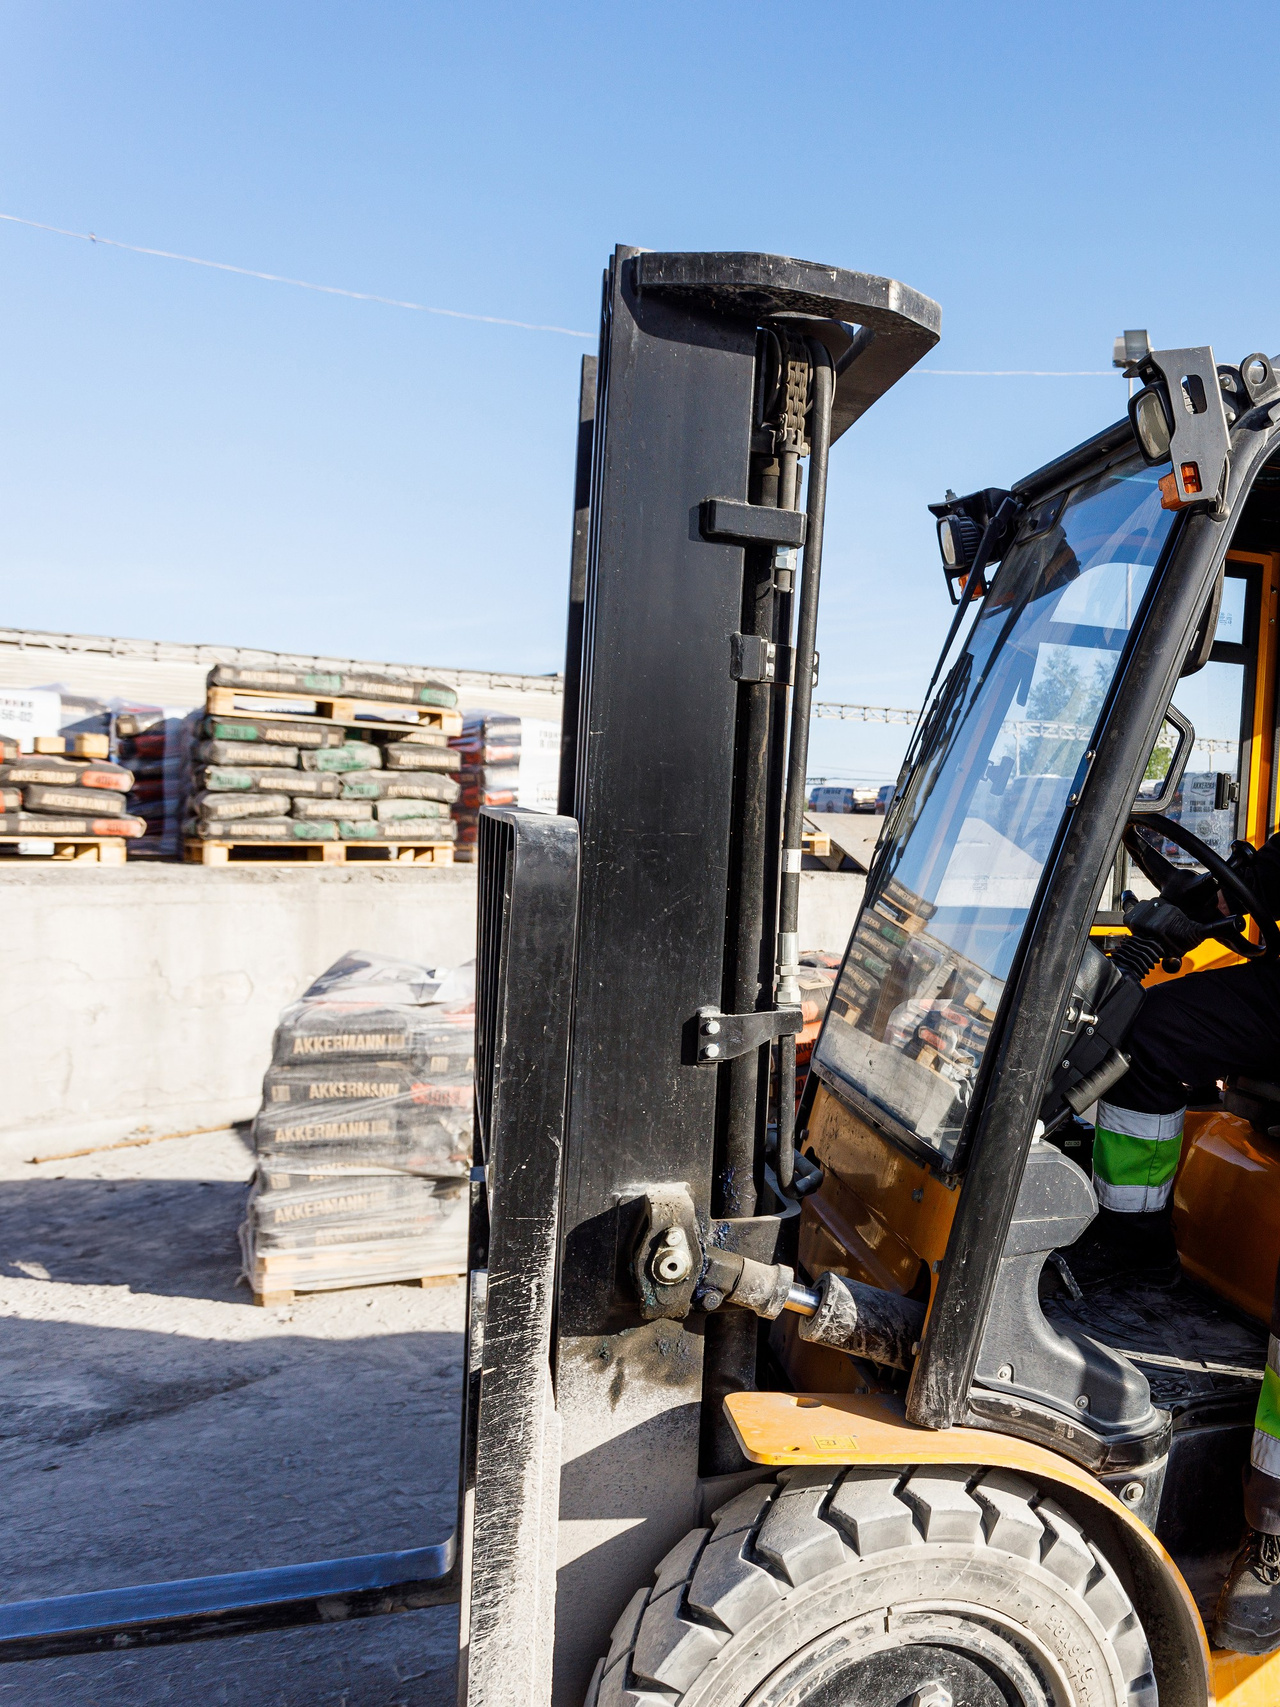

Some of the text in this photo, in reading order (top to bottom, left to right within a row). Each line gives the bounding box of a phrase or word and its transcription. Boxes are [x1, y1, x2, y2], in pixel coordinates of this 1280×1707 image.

[293, 1034, 387, 1055] AKKERMANN
[309, 1081, 400, 1099] AKKERMANN
[274, 1121, 370, 1143] AKKERMANN
[274, 1193, 370, 1224] AKKERMANN
